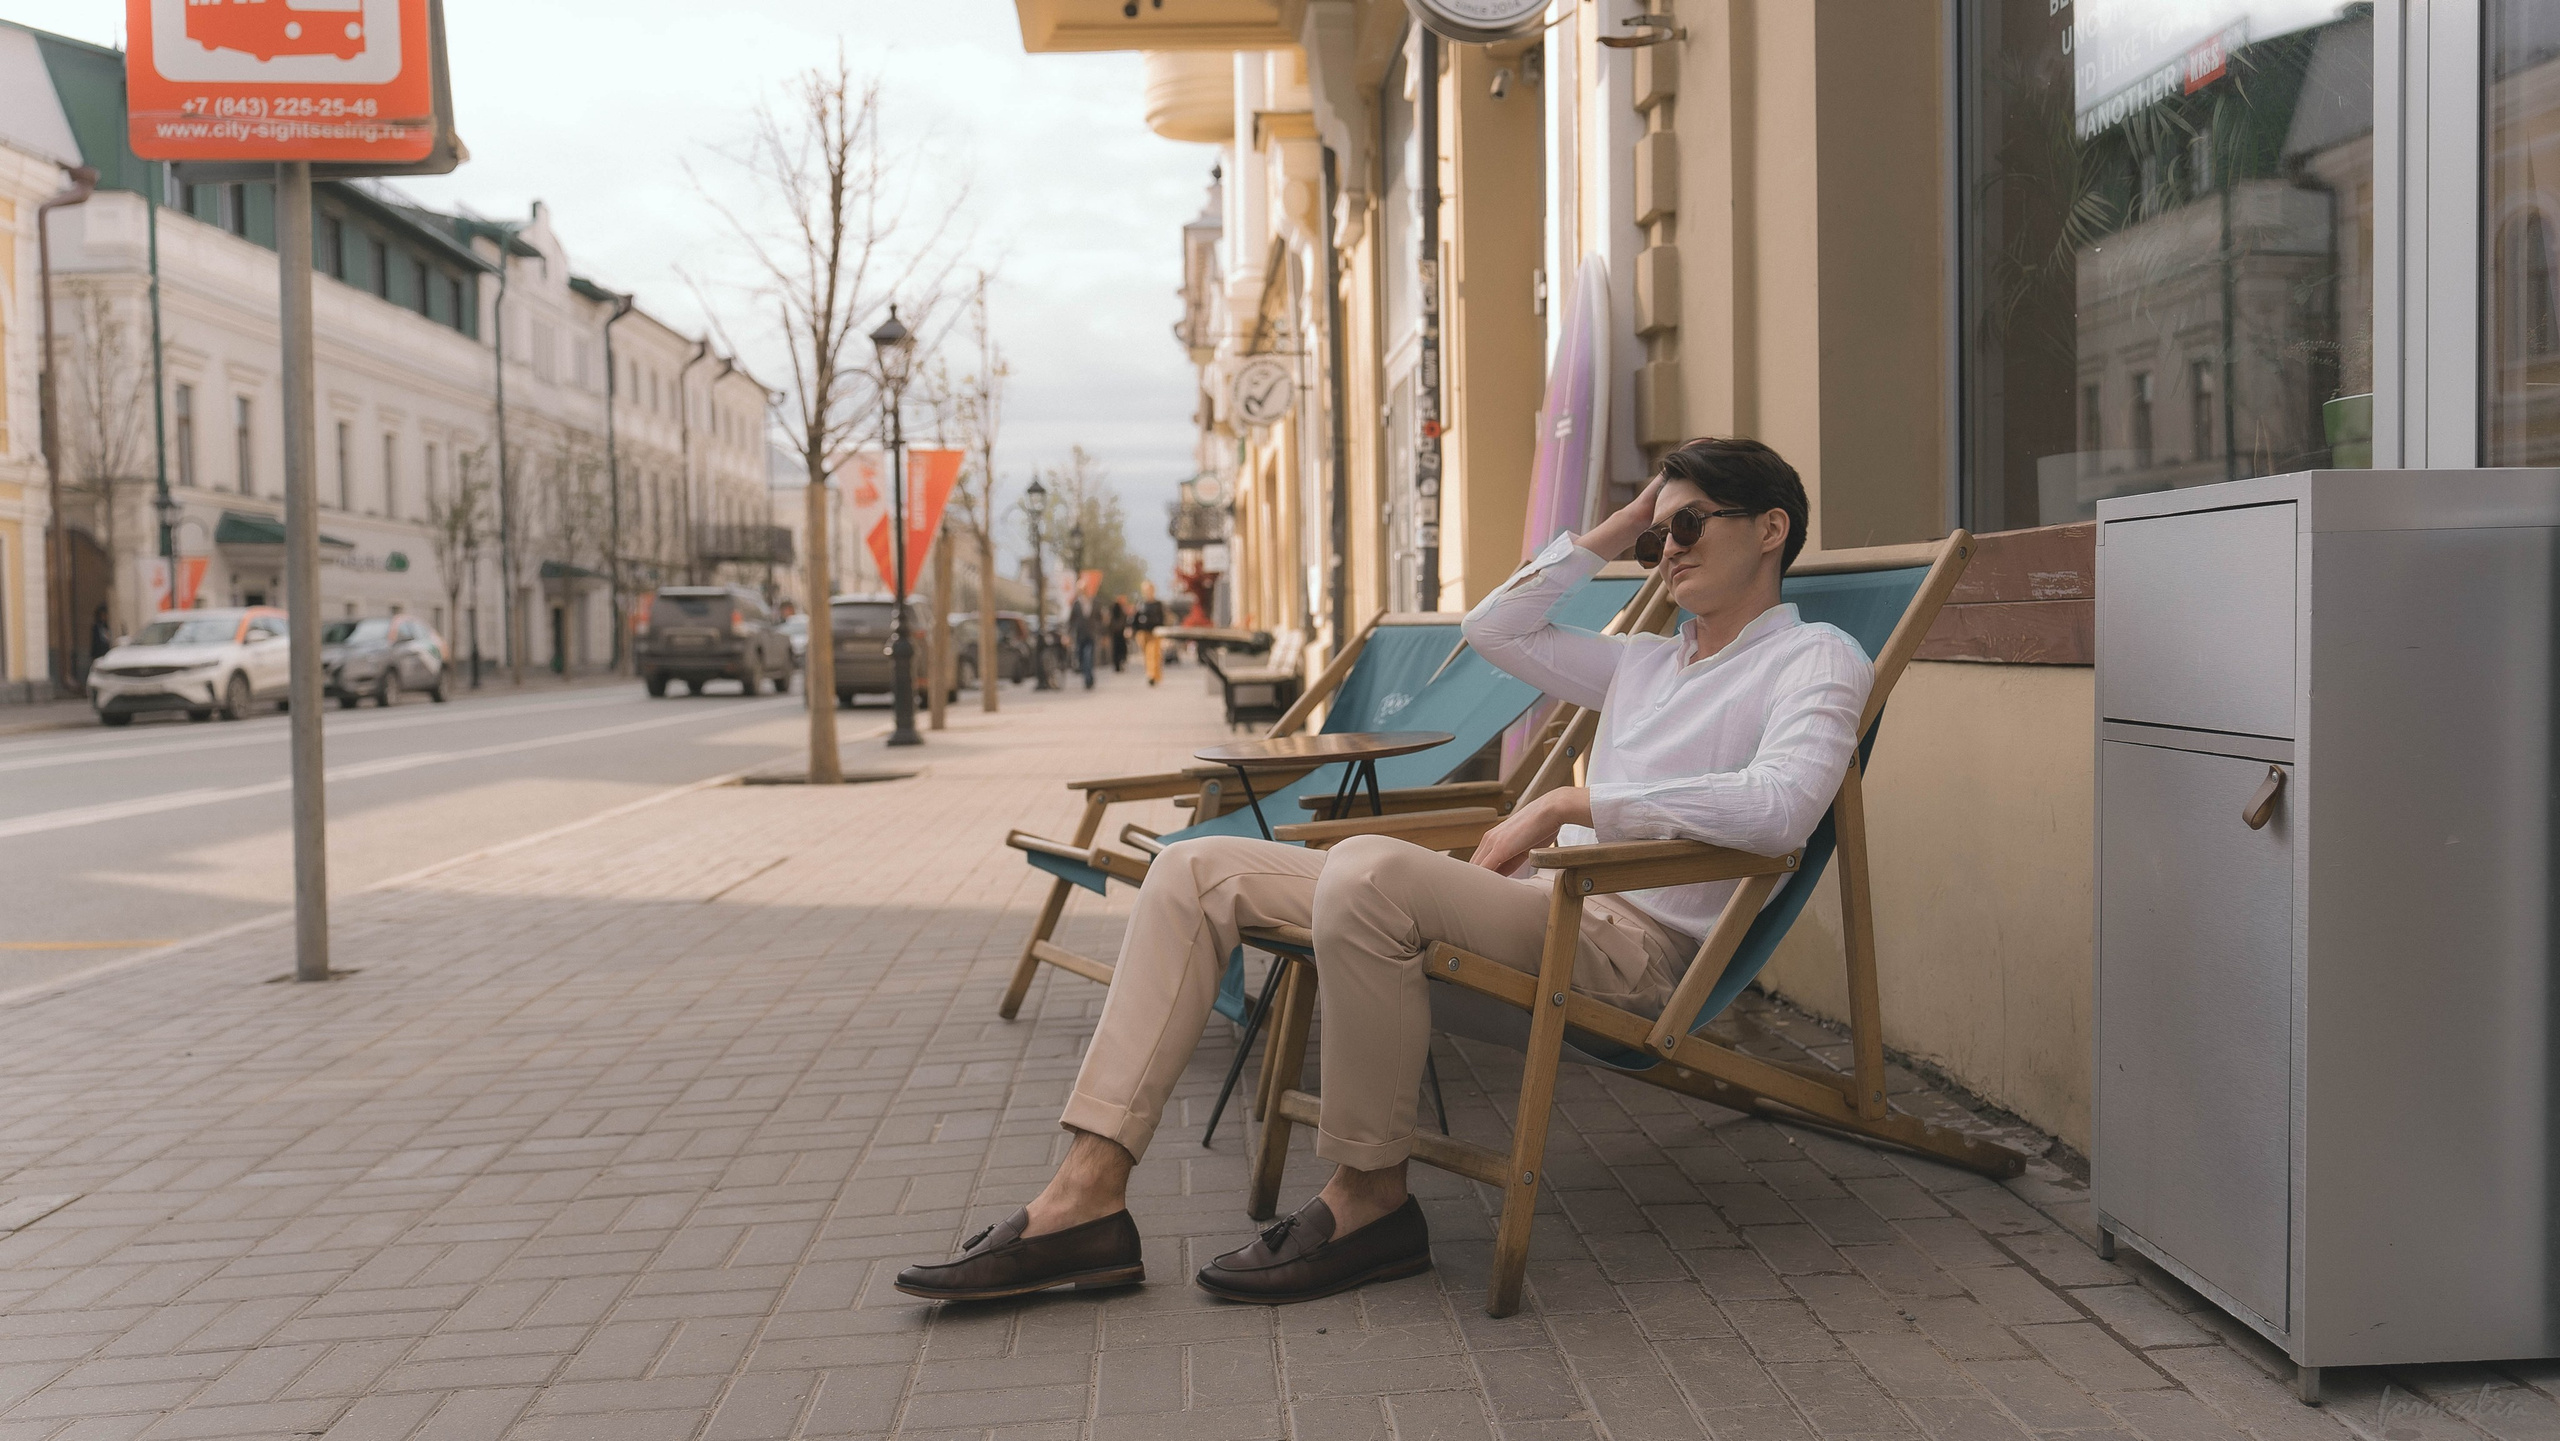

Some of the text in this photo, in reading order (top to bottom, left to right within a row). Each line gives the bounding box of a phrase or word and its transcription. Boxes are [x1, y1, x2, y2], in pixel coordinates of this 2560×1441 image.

[2074, 61, 2097, 97] I'D
[2102, 32, 2141, 80] LIKE
[2146, 13, 2174, 51] TO
[182, 97, 378, 118] +7 (843) 225-25-48
[2085, 42, 2220, 141] ANOTHER KISS
[156, 120, 405, 143] www.city-sightseeing.ru
